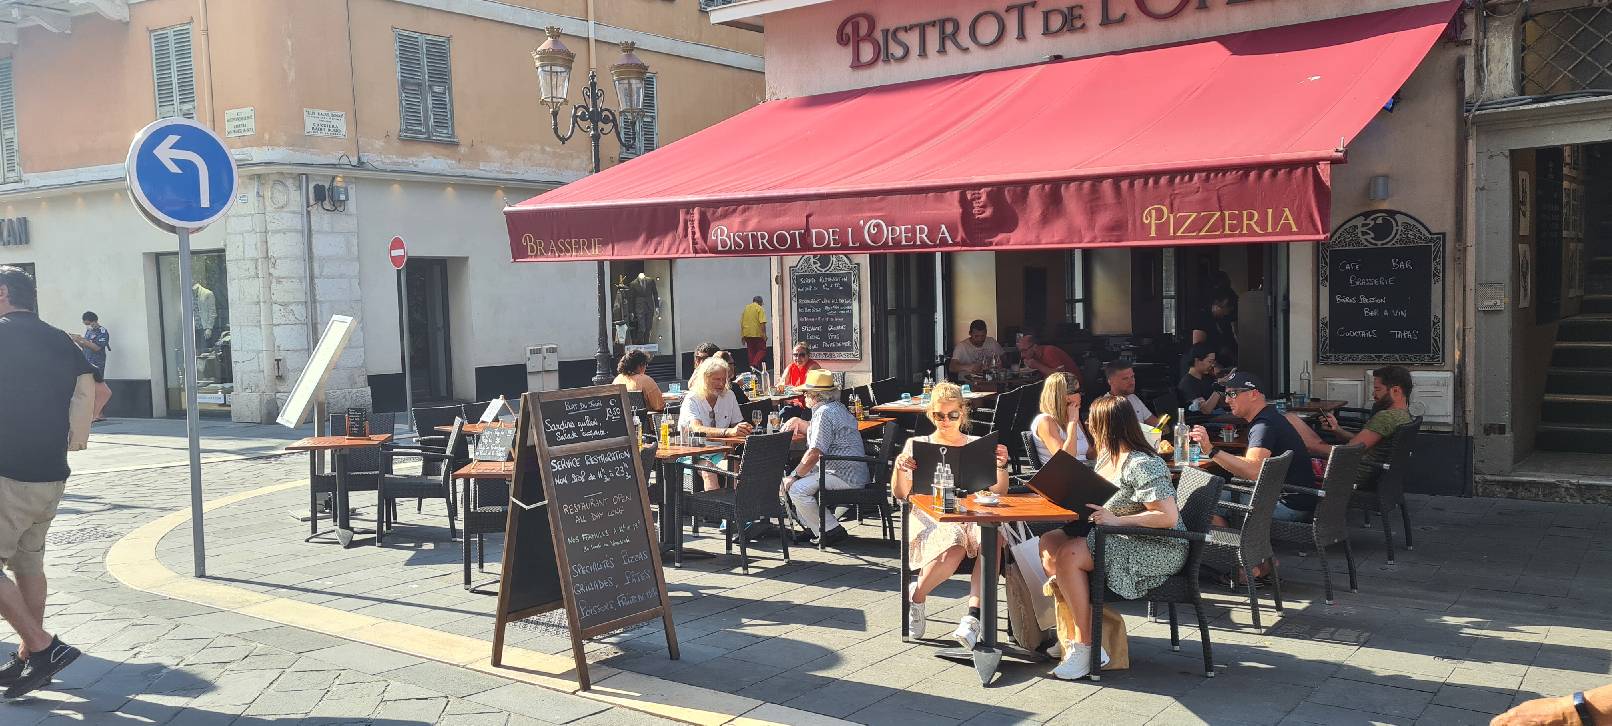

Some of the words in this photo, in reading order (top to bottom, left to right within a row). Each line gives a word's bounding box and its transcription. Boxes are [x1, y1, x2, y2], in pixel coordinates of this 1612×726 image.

[836, 1, 1038, 69] BISTROT
[1041, 4, 1086, 36] DE
[1142, 204, 1299, 237] PIZZERIA
[522, 233, 604, 256] BRASSERIE
[711, 225, 806, 250] BISTROT
[811, 228, 842, 248] DE
[848, 218, 953, 247] L'OPERA
[1391, 258, 1413, 270] BAR
[1349, 275, 1395, 287] BRASSERIE
[562, 497, 608, 515] RESTAURANT
[612, 492, 632, 505] OPEN
